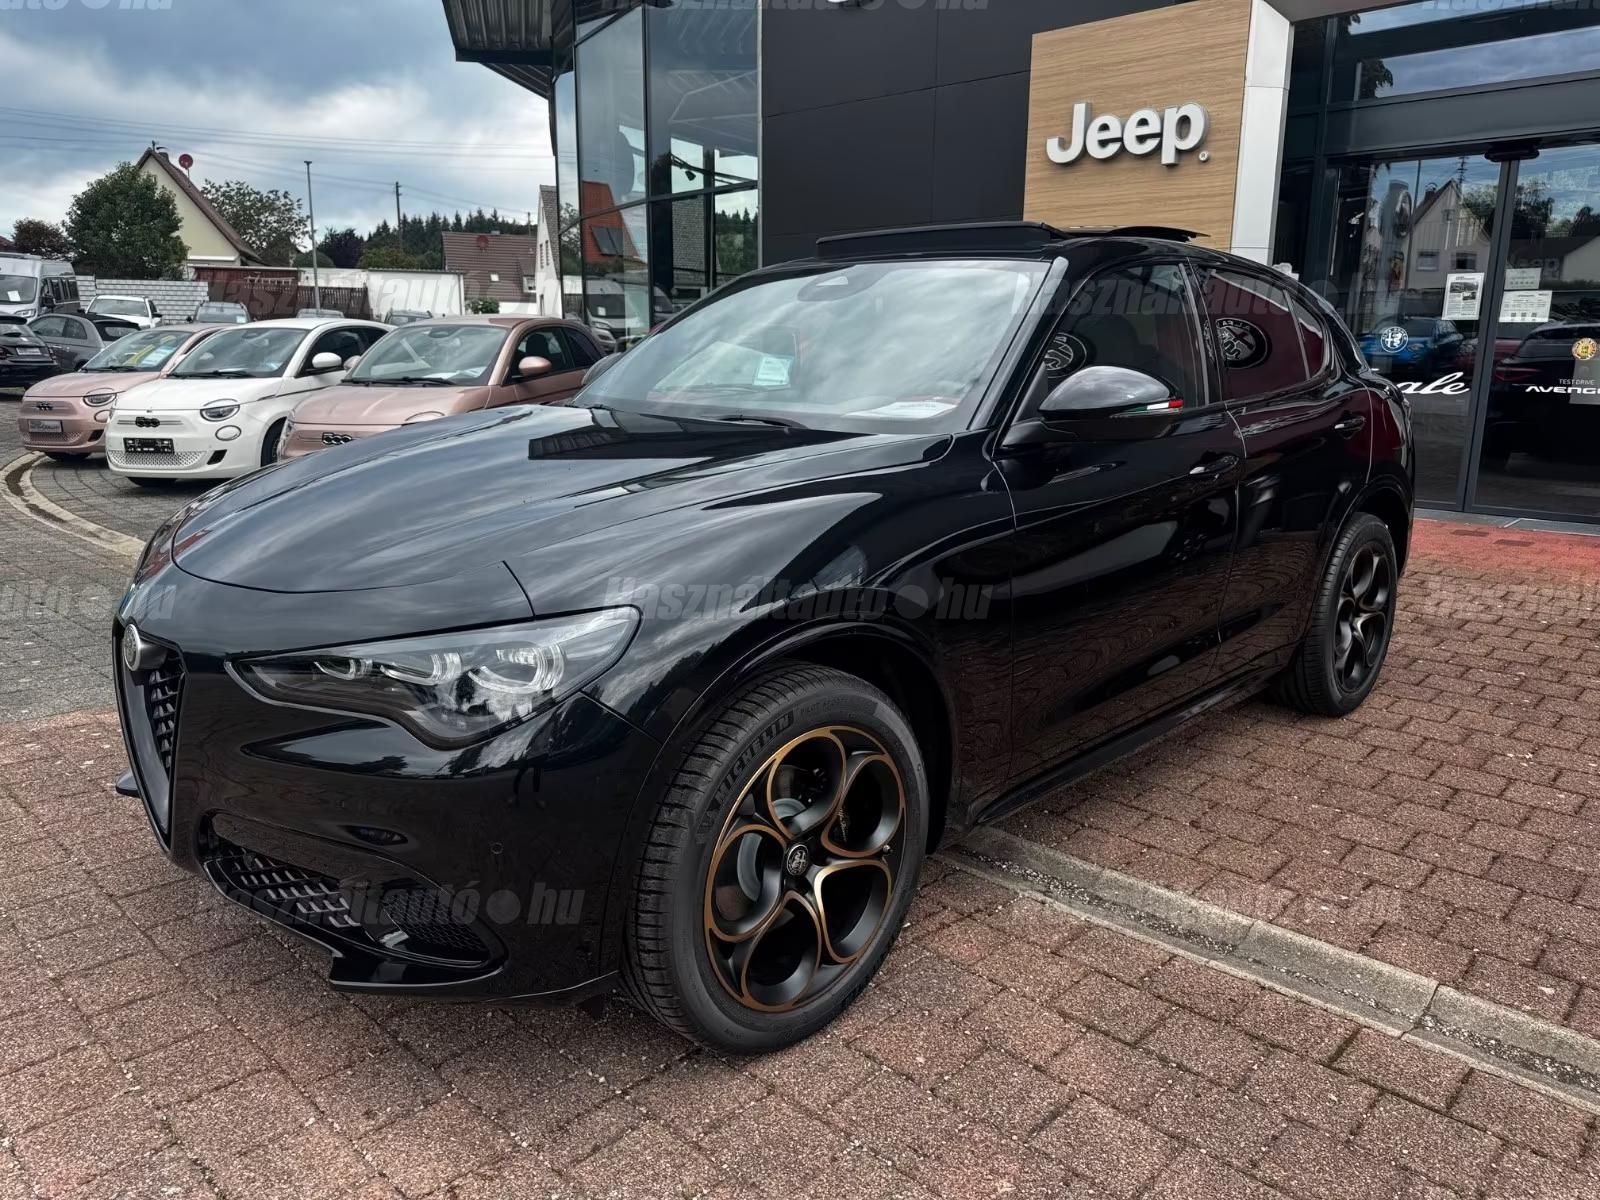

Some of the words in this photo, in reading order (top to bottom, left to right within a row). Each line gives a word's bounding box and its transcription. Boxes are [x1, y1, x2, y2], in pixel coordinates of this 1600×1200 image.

[1046, 102, 1208, 166] Jeep
[1396, 371, 1471, 395] ale
[1525, 385, 1600, 395] AVENG
[1559, 378, 1575, 386] TEST
[715, 713, 790, 803] MICHELIN
